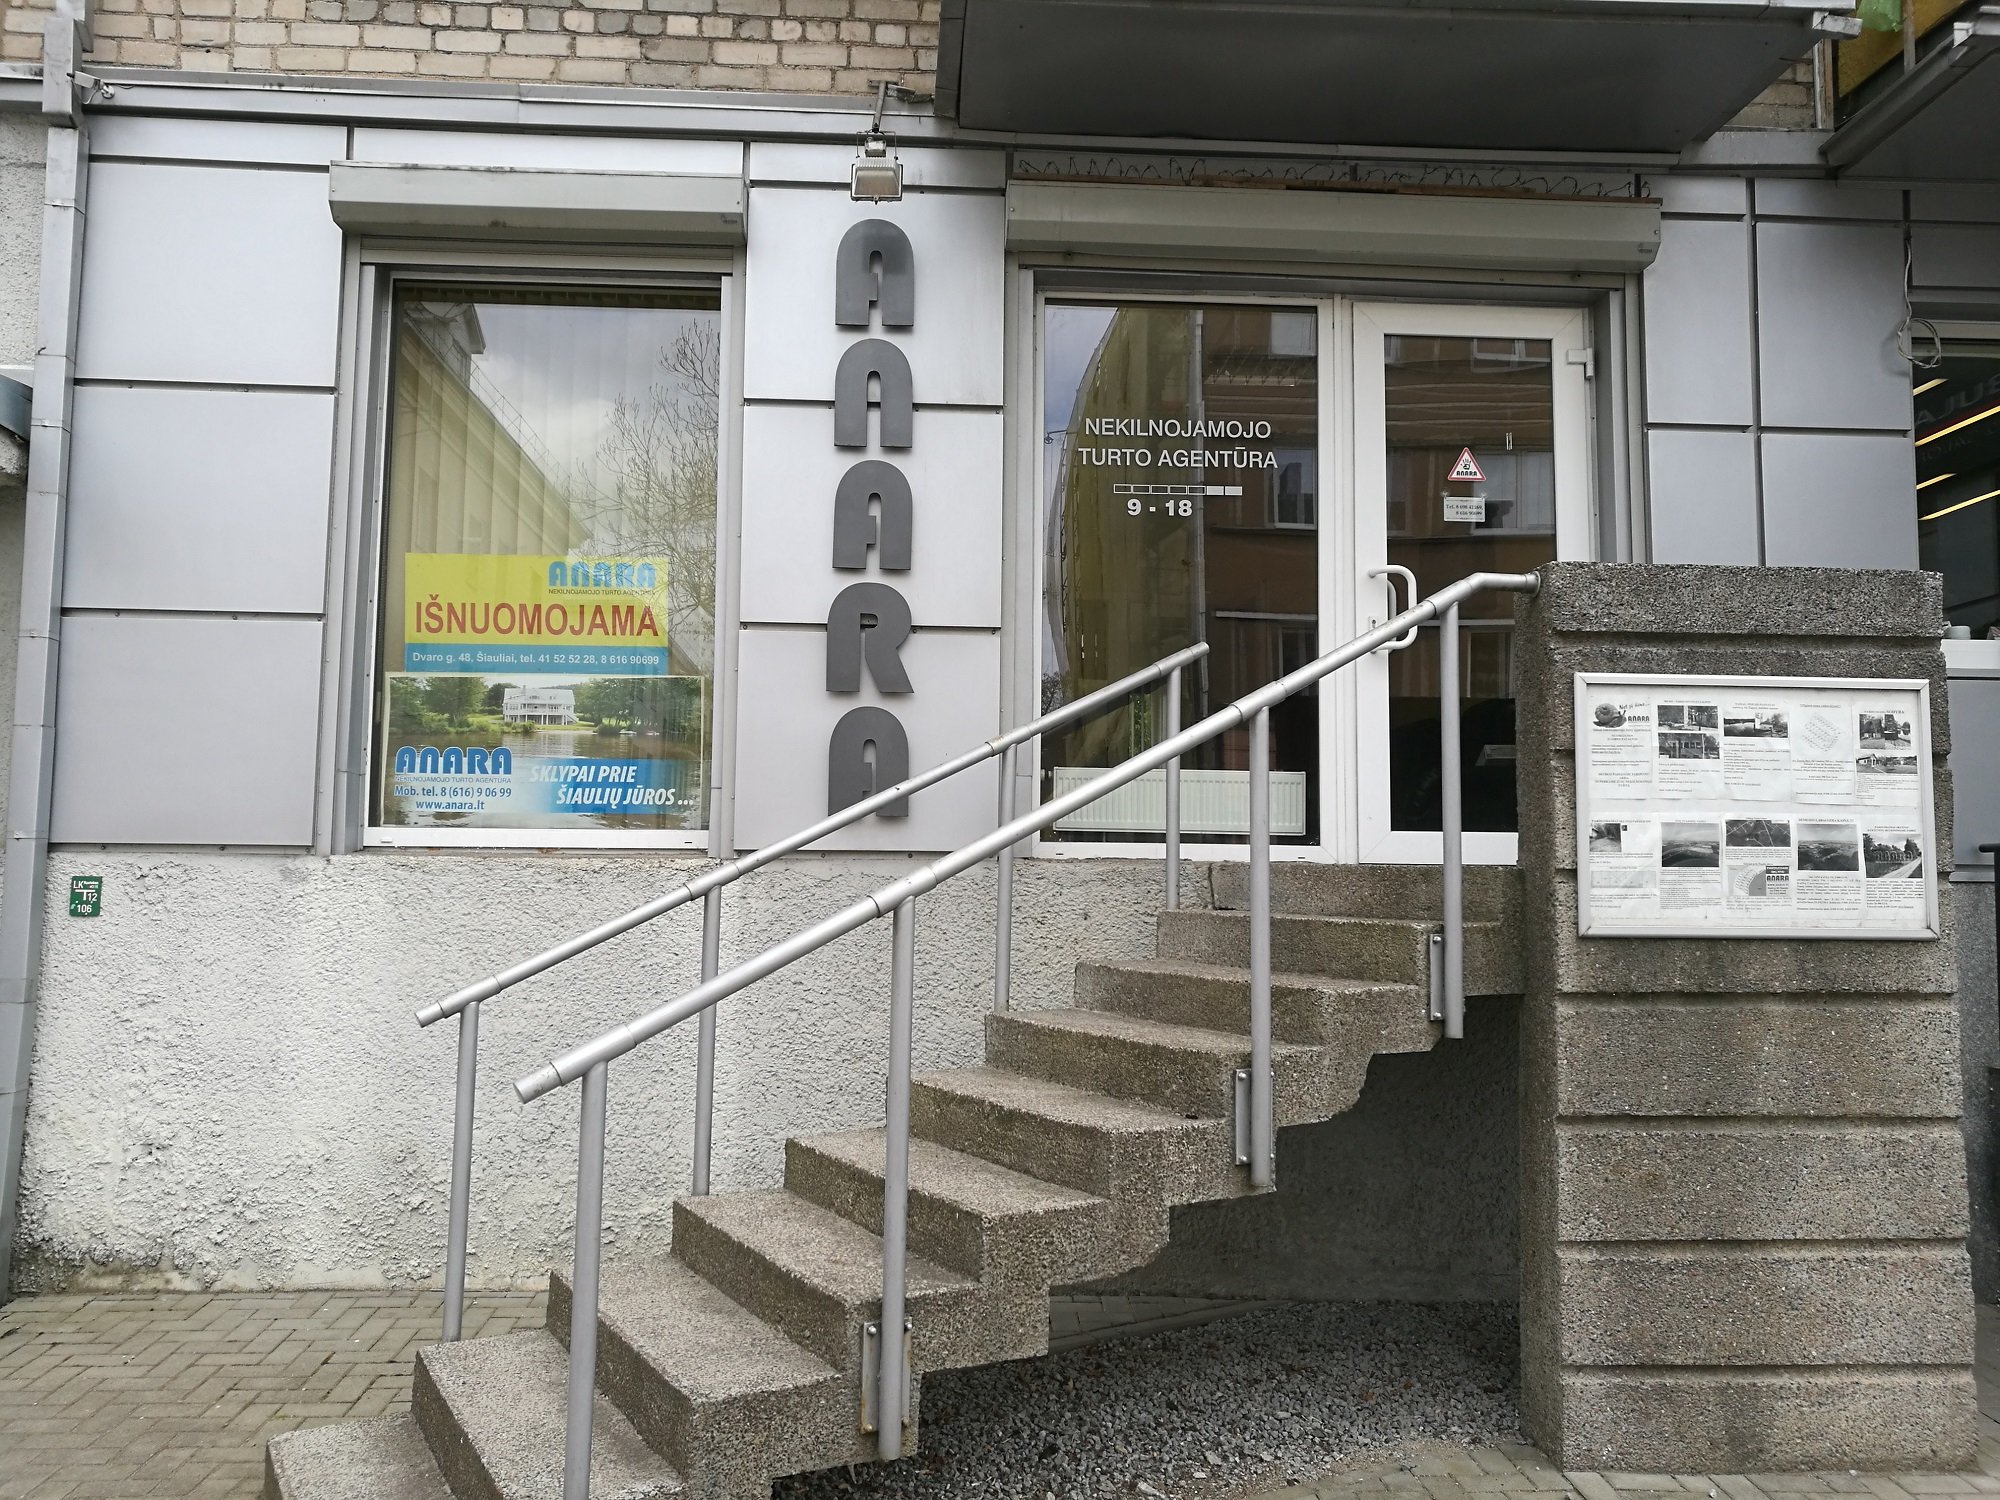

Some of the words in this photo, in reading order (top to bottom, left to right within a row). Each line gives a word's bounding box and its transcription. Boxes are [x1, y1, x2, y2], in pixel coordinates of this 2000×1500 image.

[1085, 418, 1272, 439] NEKILNOJAMOJO
[1078, 447, 1152, 467] TURTO
[1157, 446, 1279, 469] AGENTŪRA
[1127, 498, 1142, 516] 9
[1165, 499, 1193, 516] 18
[826, 219, 914, 817] ANARA
[548, 561, 656, 588] ANARA
[416, 594, 659, 637] IŠNUOMOJAMA
[413, 652, 443, 662] Dvaro
[446, 655, 456, 664] g.
[476, 651, 517, 664] Šiauliai,
[520, 653, 535, 663] tel.
[538, 654, 550, 663] 41
[553, 654, 565, 664] 52
[569, 654, 581, 664] 52
[583, 654, 598, 666] 28,
[601, 655, 607, 664] 8
[609, 655, 627, 664] 616
[629, 655, 659, 665] 90699
[395, 746, 512, 775] ANARA
[530, 765, 596, 783] SKLYPAI
[598, 765, 638, 783] PRIE
[394, 786, 419, 796] Mob.
[422, 786, 438, 796] tel.
[440, 786, 447, 796] 8
[449, 786, 474, 798] (616)
[477, 787, 483, 797] 9
[485, 787, 497, 798] 06
[499, 787, 512, 798] 99
[556, 784, 623, 809] ŠIAULIŲ
[623, 785, 676, 805] JŪROS
[416, 800, 485, 810] www.anara.lt
[73, 880, 84, 889] LK
[77, 904, 92, 913] 106
